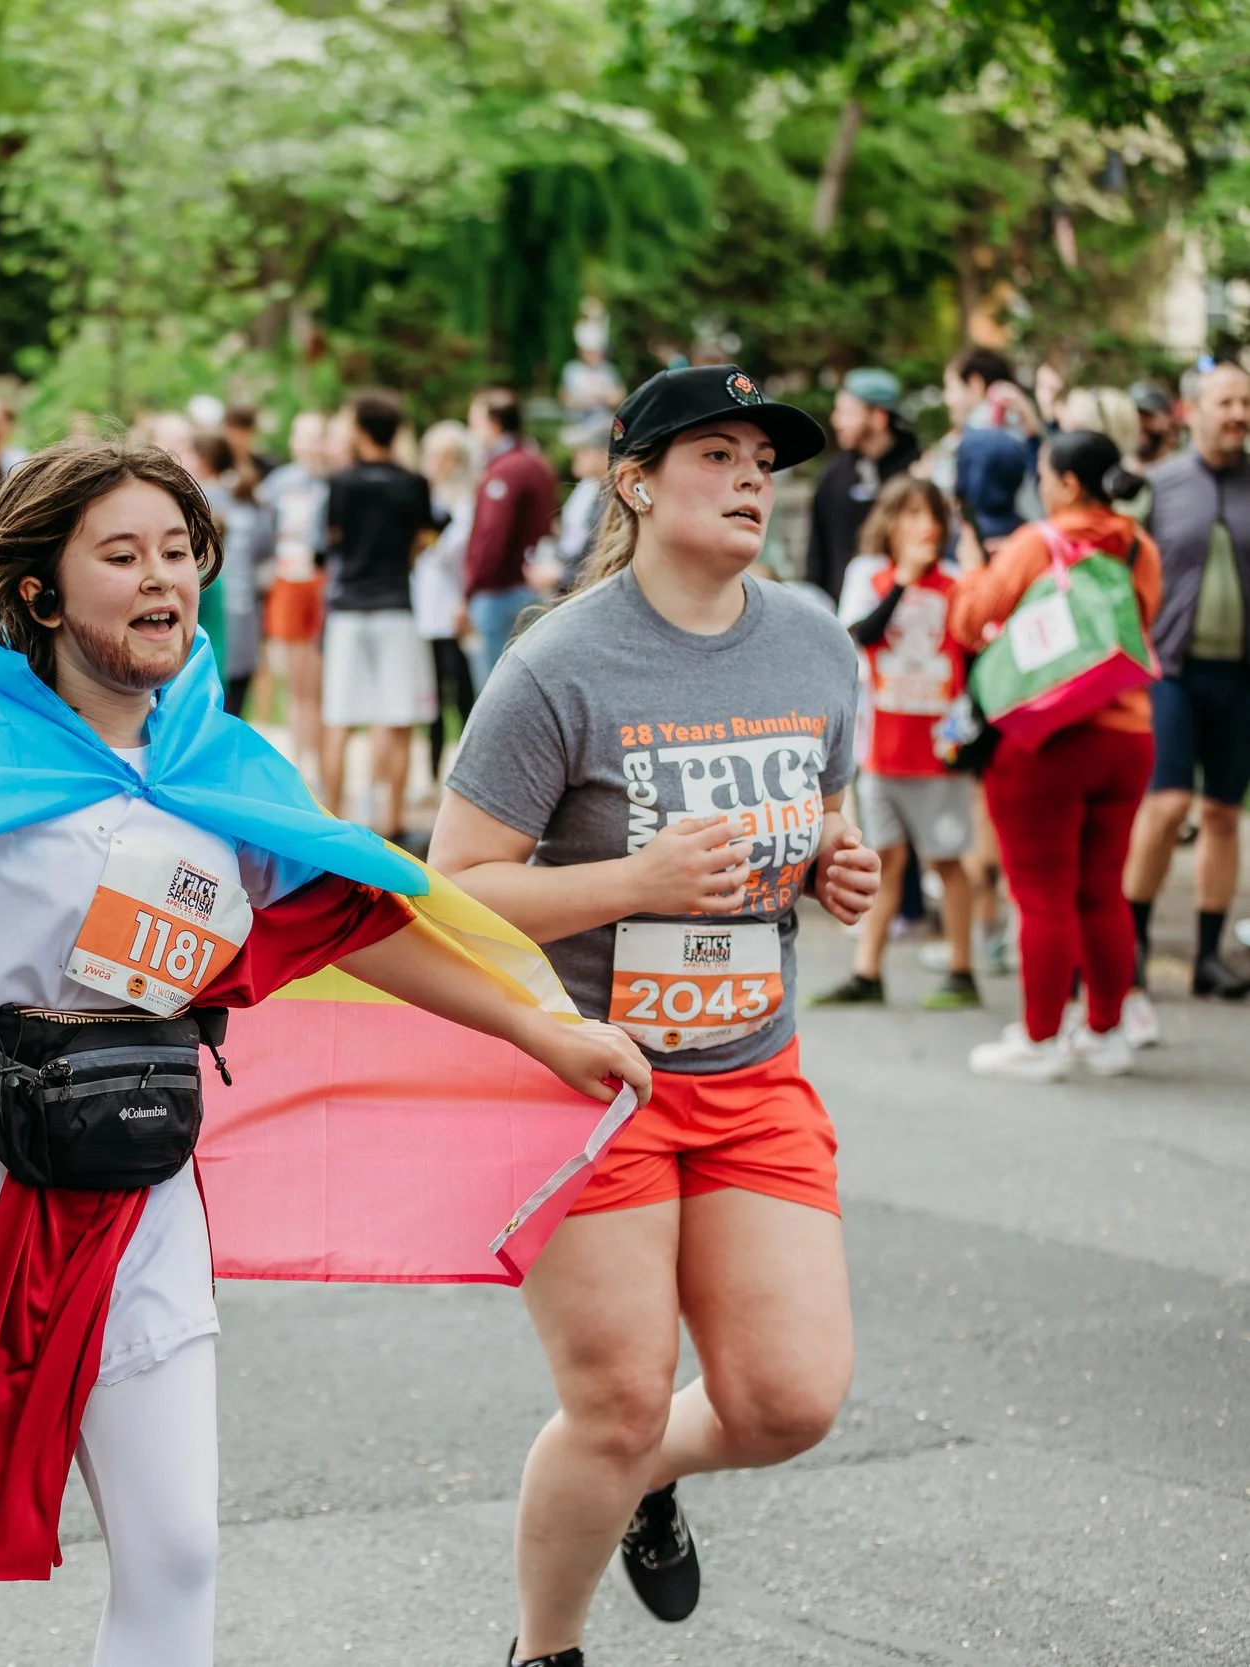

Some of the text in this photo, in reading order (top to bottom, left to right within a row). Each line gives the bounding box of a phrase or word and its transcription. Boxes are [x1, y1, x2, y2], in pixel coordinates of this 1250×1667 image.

[620, 711, 827, 747] 28 Years Running!
[623, 750, 659, 855] wca
[167, 866, 183, 900] ywca
[180, 873, 218, 899] race
[165, 898, 183, 910] APRIL
[174, 891, 214, 916] RACISM
[128, 909, 217, 989] 1181
[83, 964, 112, 980] ywca
[625, 978, 770, 1023] 2043
[127, 1105, 167, 1119] Columbia
